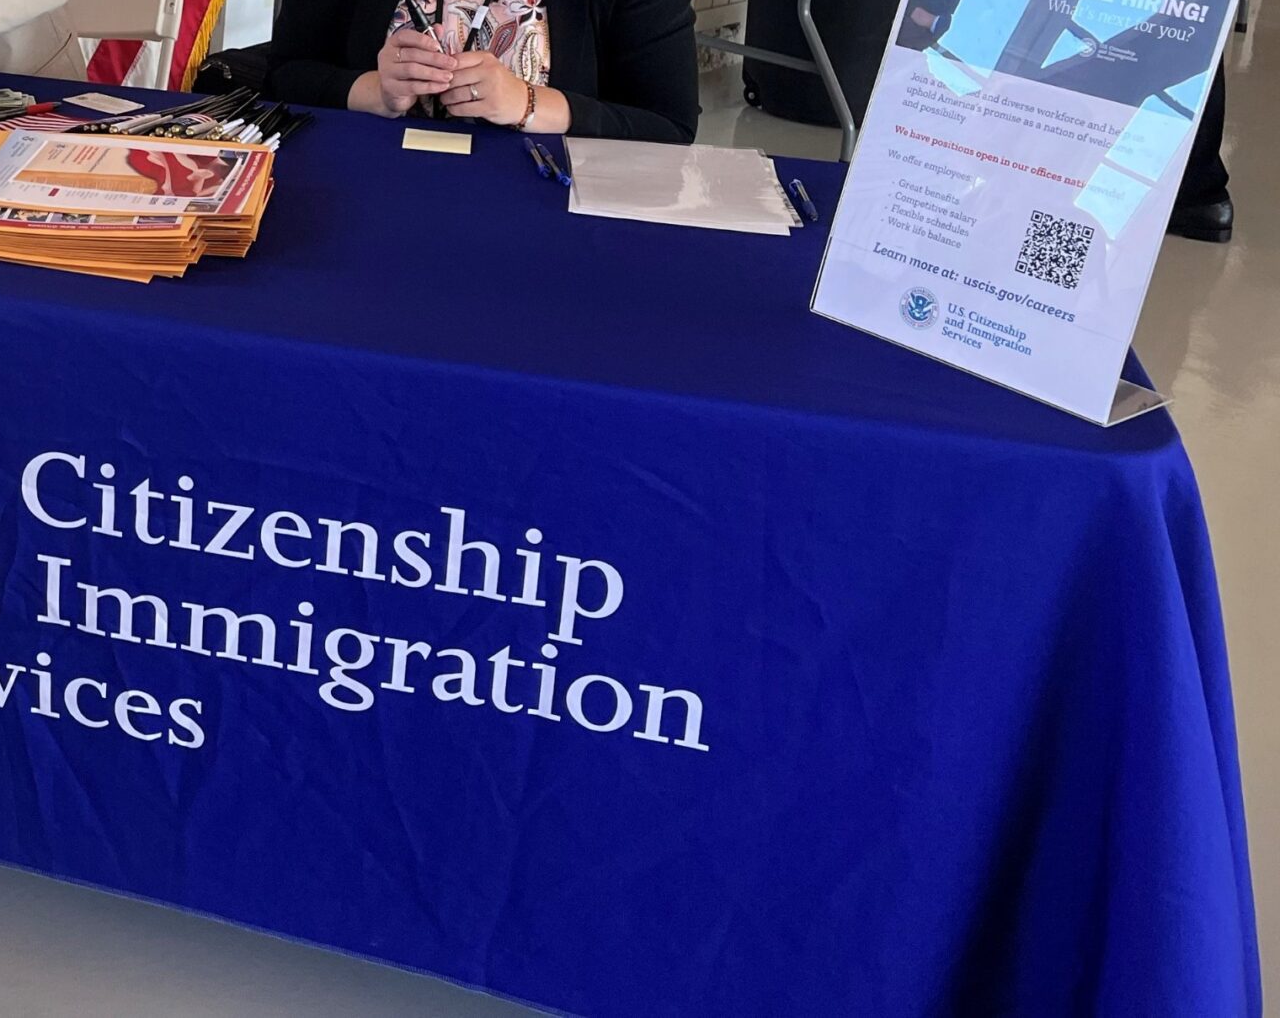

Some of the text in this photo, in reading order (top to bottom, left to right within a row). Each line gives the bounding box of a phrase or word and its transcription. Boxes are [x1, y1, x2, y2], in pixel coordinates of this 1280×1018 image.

[1099, 12, 1130, 27] next
[1133, 17, 1156, 34] for
[1157, 26, 1196, 43] you?
[902, 98, 919, 109] and
[906, 86, 937, 100] uphold
[937, 93, 982, 112] America's
[983, 107, 1022, 124] promise
[1023, 119, 1034, 128] as
[1043, 123, 1075, 139] nation
[1077, 133, 1090, 143] of
[910, 72, 928, 84] Join
[982, 92, 1001, 104] and
[1001, 97, 1035, 113] diverse
[1037, 107, 1086, 127] workforce
[1087, 120, 1108, 133] and
[888, 149, 901, 160] We
[902, 155, 923, 167] offer
[895, 125, 909, 136] We
[909, 129, 931, 143] have
[931, 138, 975, 157] positions
[975, 150, 999, 164] open
[1000, 156, 1011, 167] in
[1012, 162, 1030, 173] our
[1030, 167, 1063, 182] offices
[895, 192, 978, 227] Competitive salary
[898, 178, 961, 206] Great benefits
[888, 216, 962, 249] Work life balance
[891, 204, 970, 237] Flexible schedules
[873, 242, 1076, 324] Learn more at: uscis.gov/careers
[941, 326, 983, 351] Services
[944, 315, 1033, 356] and Immigration
[947, 302, 967, 319] U.S.
[968, 310, 1028, 342] Citizenship
[20, 450, 624, 647] Citizenship
[36, 553, 712, 753] Immigration
